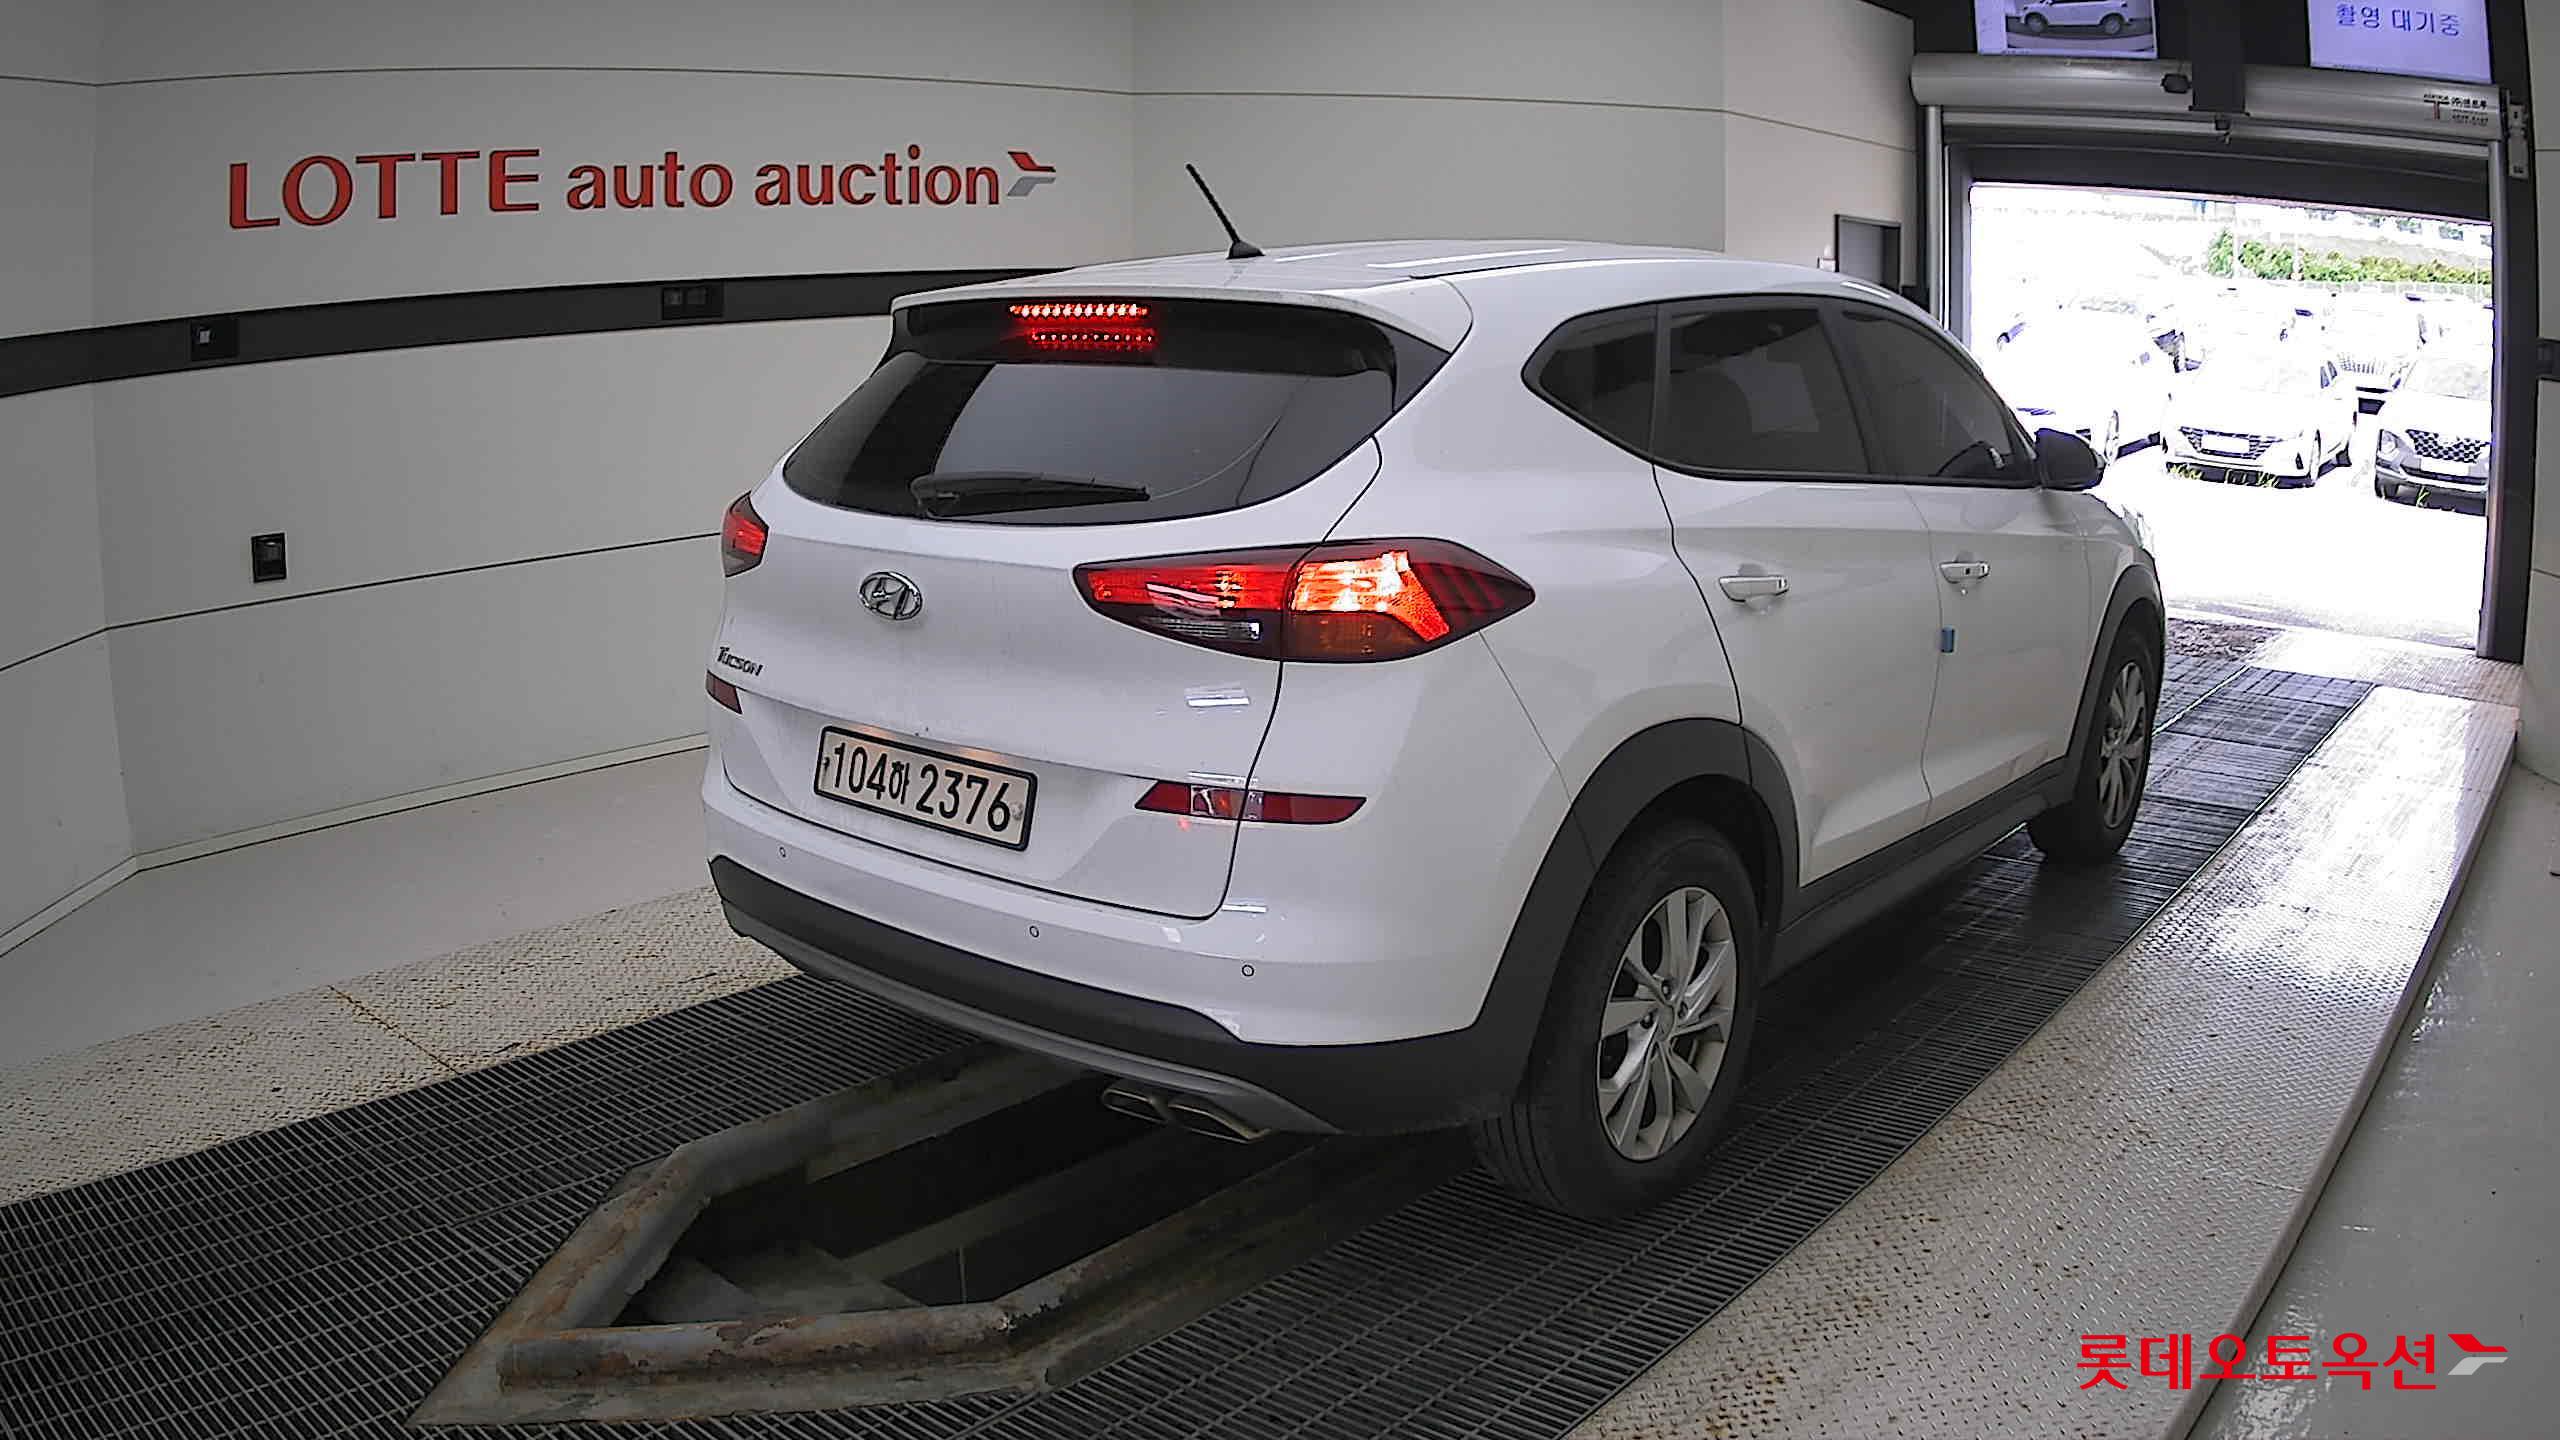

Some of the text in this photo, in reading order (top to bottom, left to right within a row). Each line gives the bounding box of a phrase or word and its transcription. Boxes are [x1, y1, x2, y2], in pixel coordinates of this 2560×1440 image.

[2337, 4, 2460, 36] 촬영 대기중
[229, 145, 1001, 230] LOTTE auto auction
[915, 764, 1011, 832] 2376
